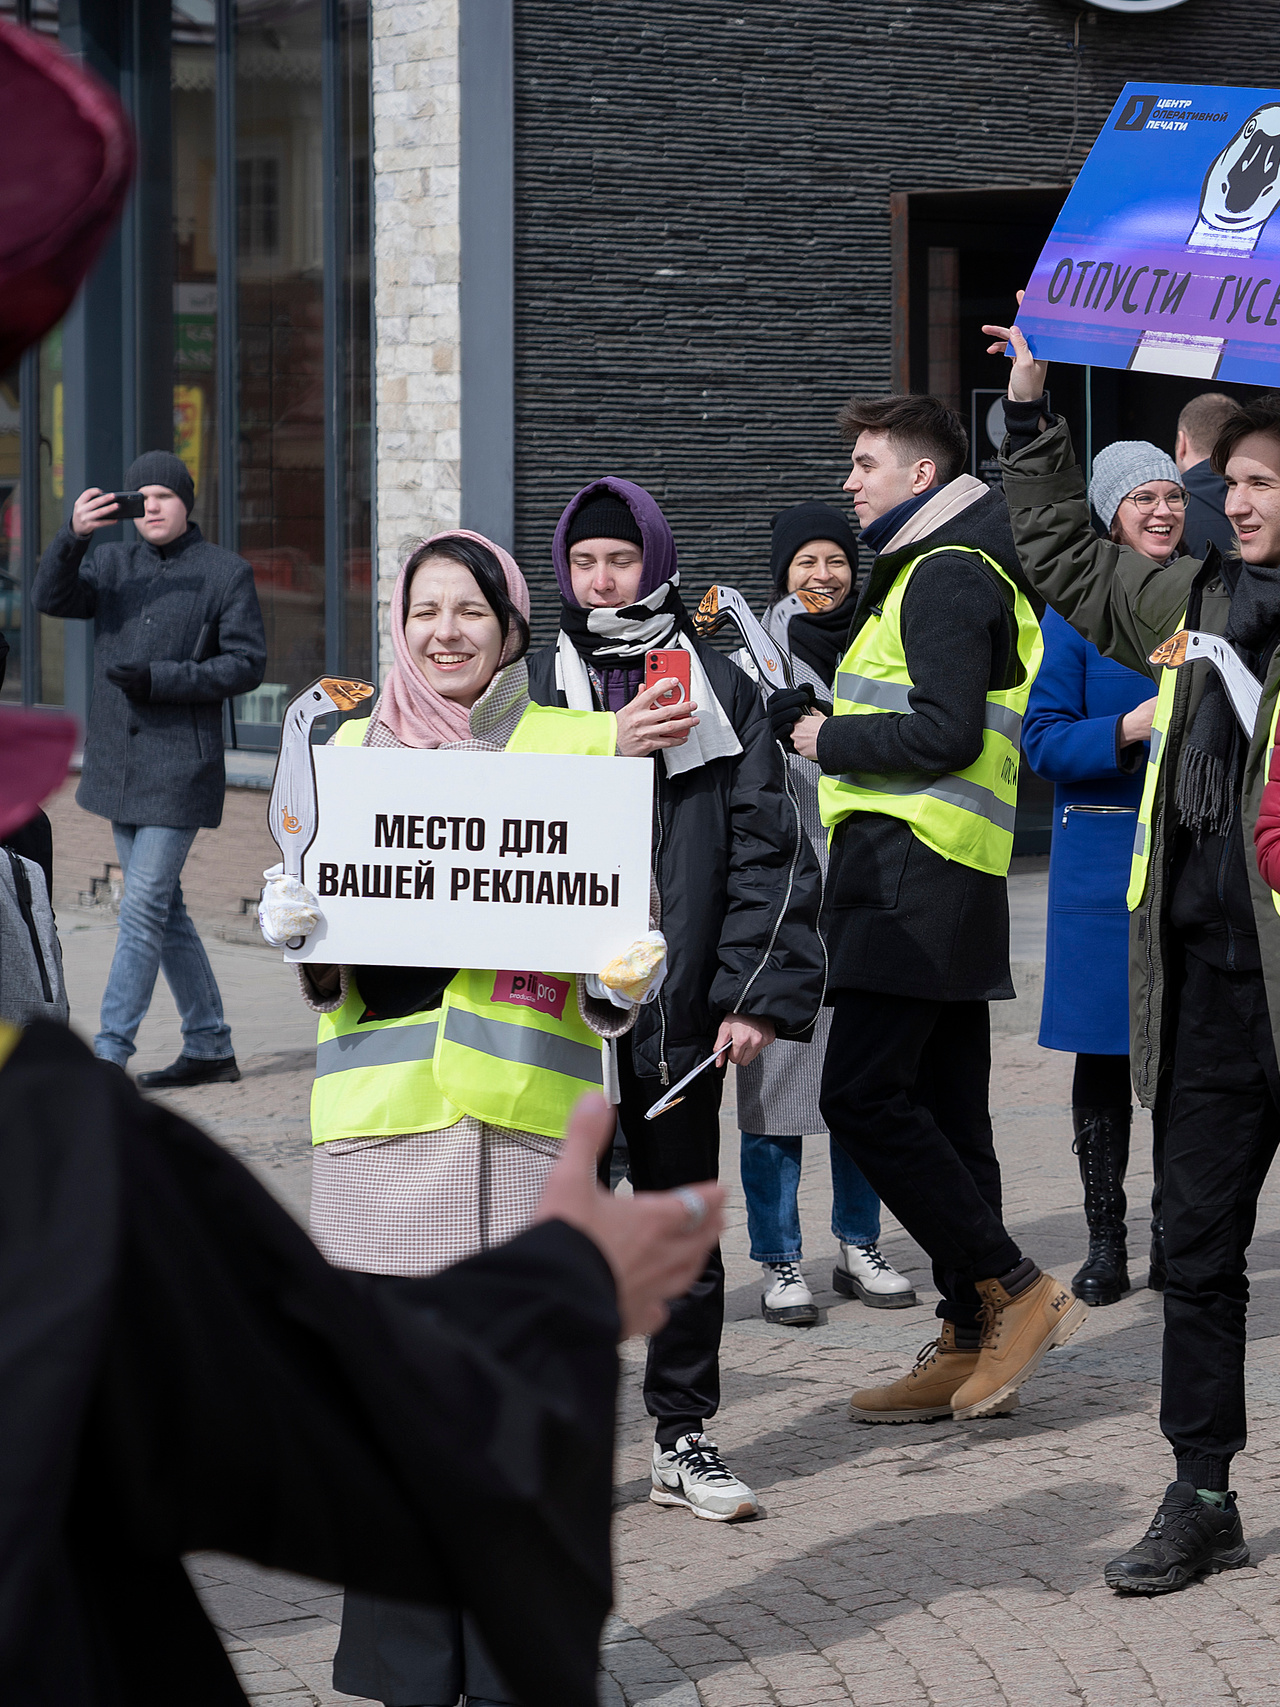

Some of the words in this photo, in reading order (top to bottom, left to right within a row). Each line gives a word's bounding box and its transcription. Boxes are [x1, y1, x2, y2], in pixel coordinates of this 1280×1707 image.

[1152, 110, 1230, 122] ОПЕРАТИВНОЙ
[1156, 99, 1193, 109] ЦЕНТР
[1145, 120, 1189, 131] ПЕЧАТИ
[1047, 257, 1191, 315] ОТПУСТИ
[374, 813, 486, 851] МЕСТО
[499, 818, 568, 858] ДЛЯ
[317, 860, 435, 900] ВАШЕЙ
[450, 867, 620, 908] РЕКЛАМЫ
